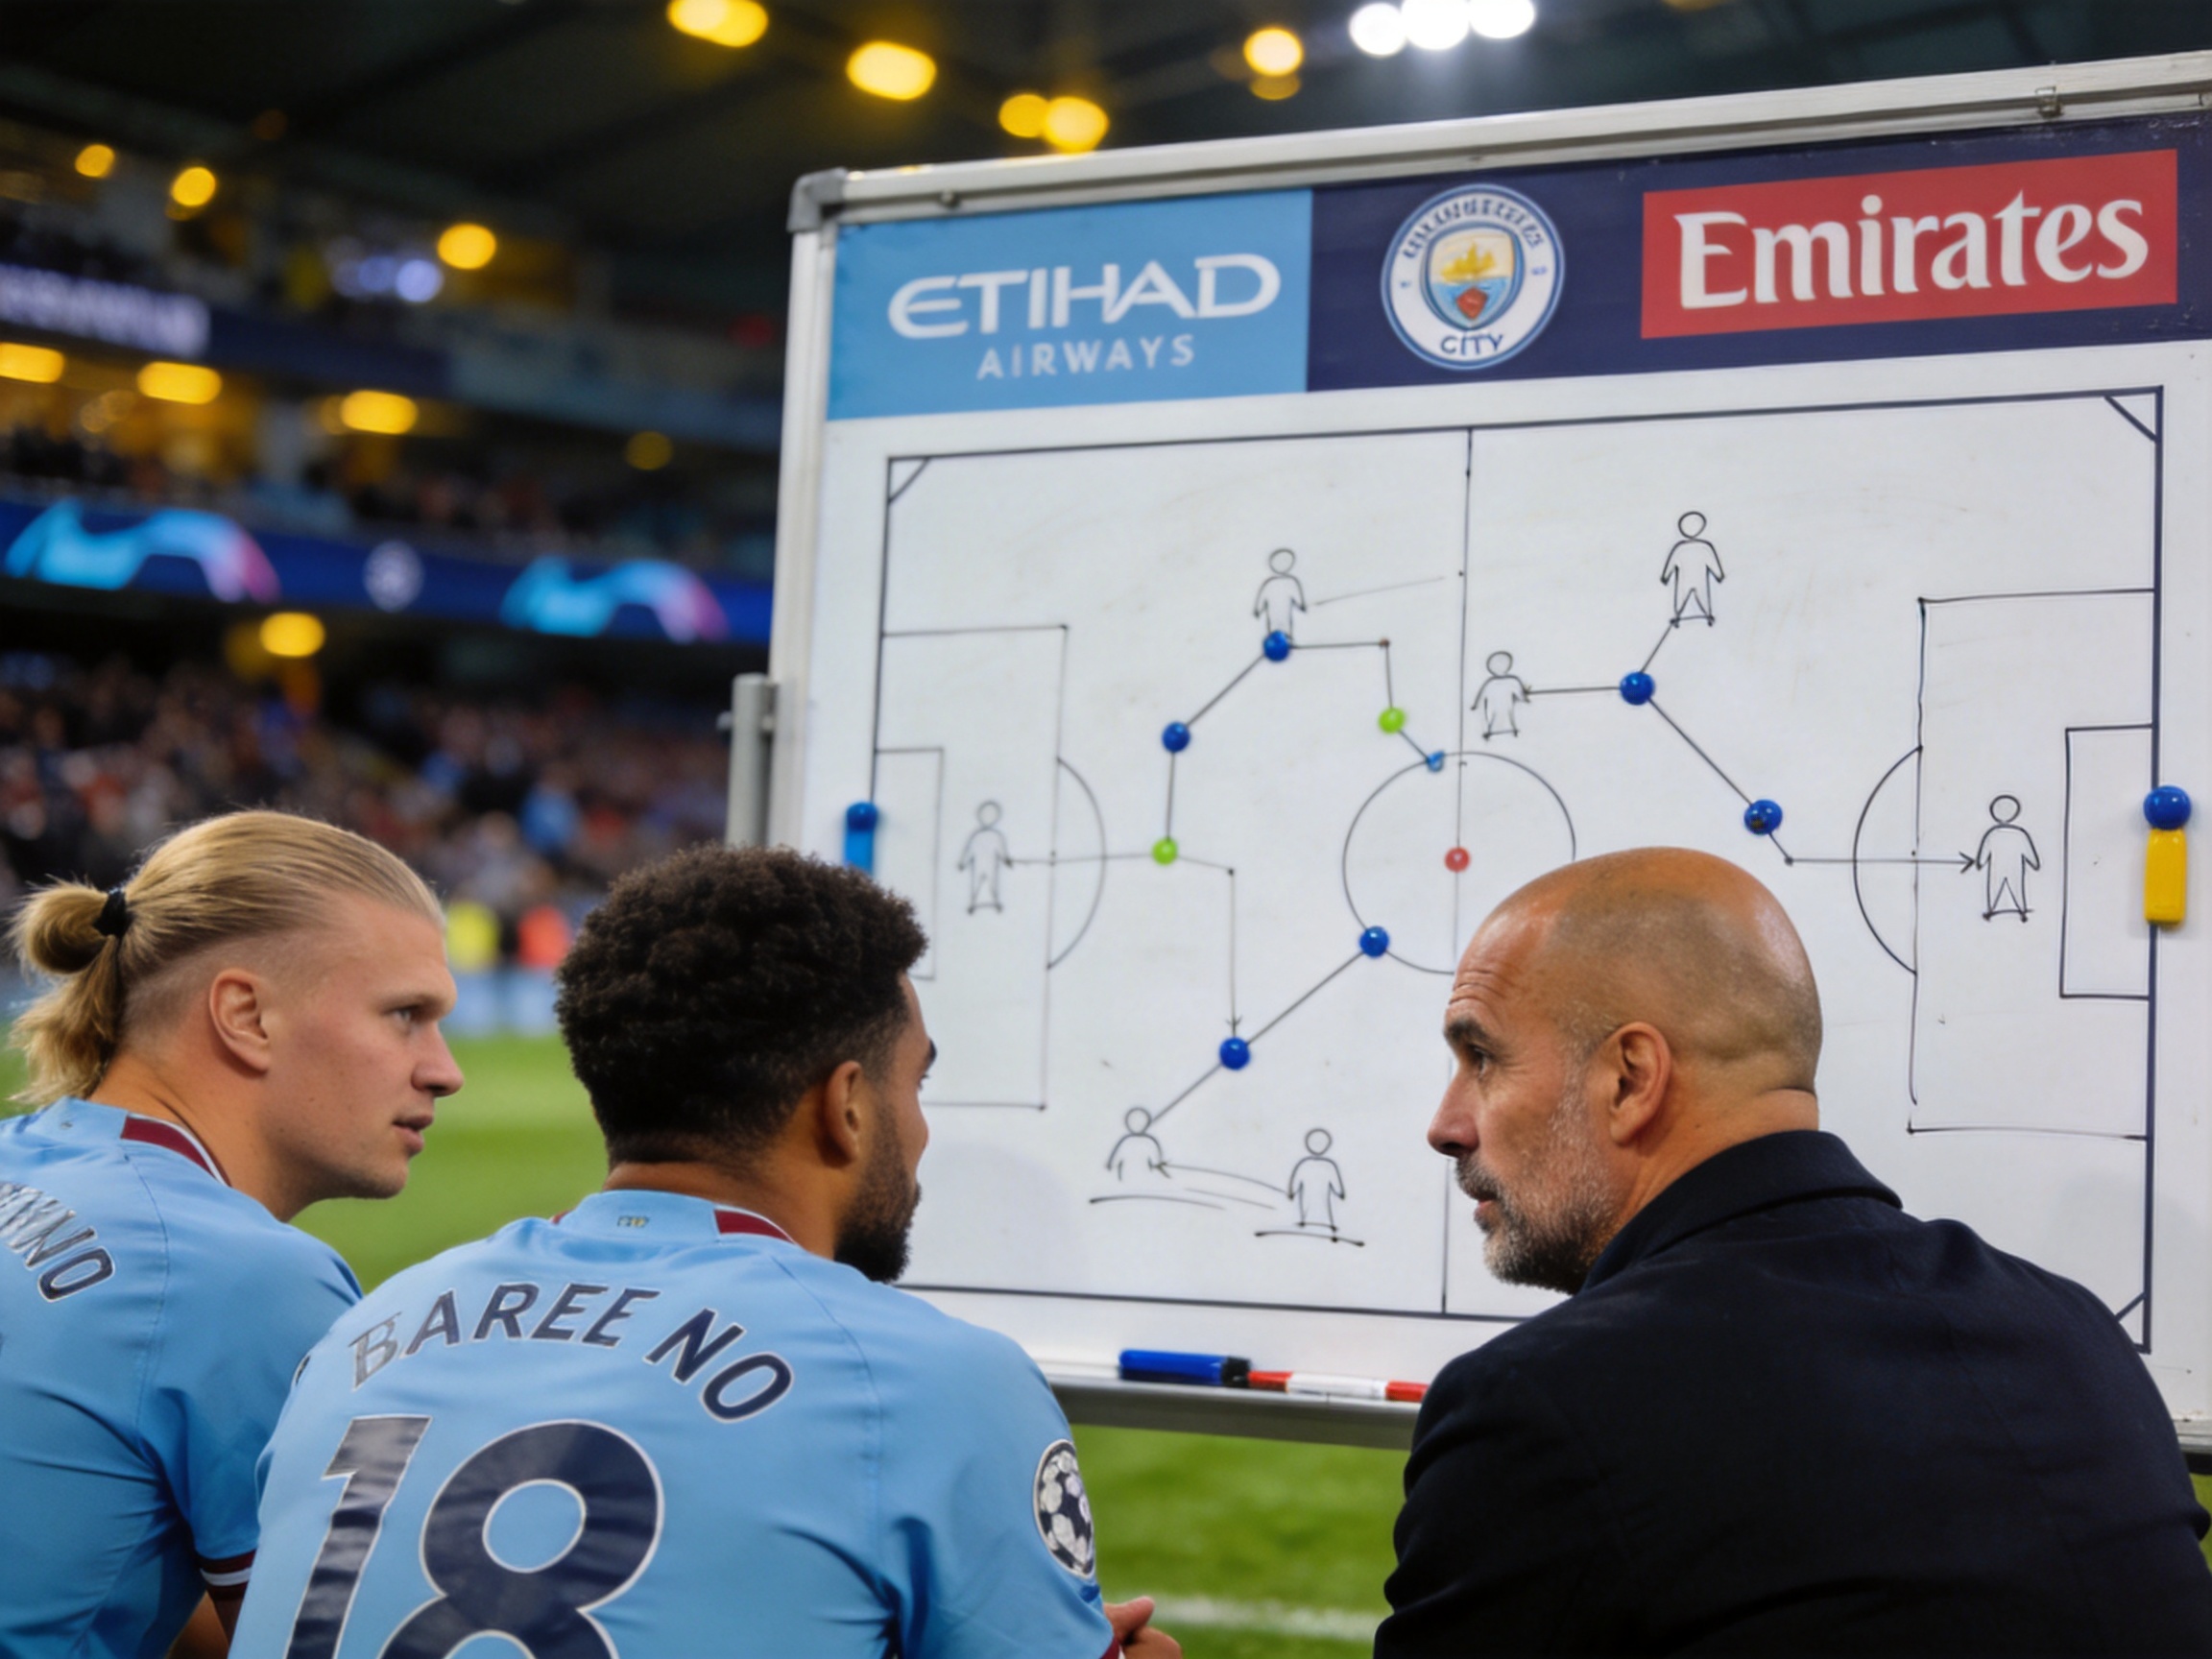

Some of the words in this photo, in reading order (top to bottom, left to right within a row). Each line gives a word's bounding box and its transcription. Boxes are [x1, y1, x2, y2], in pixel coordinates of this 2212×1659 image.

[1673, 189, 2149, 310] Emirates
[888, 252, 1282, 340] ETIHAD
[976, 334, 1195, 380] AIRWAYS
[1440, 332, 1503, 356] CITY
[284, 1414, 665, 1659] 18
